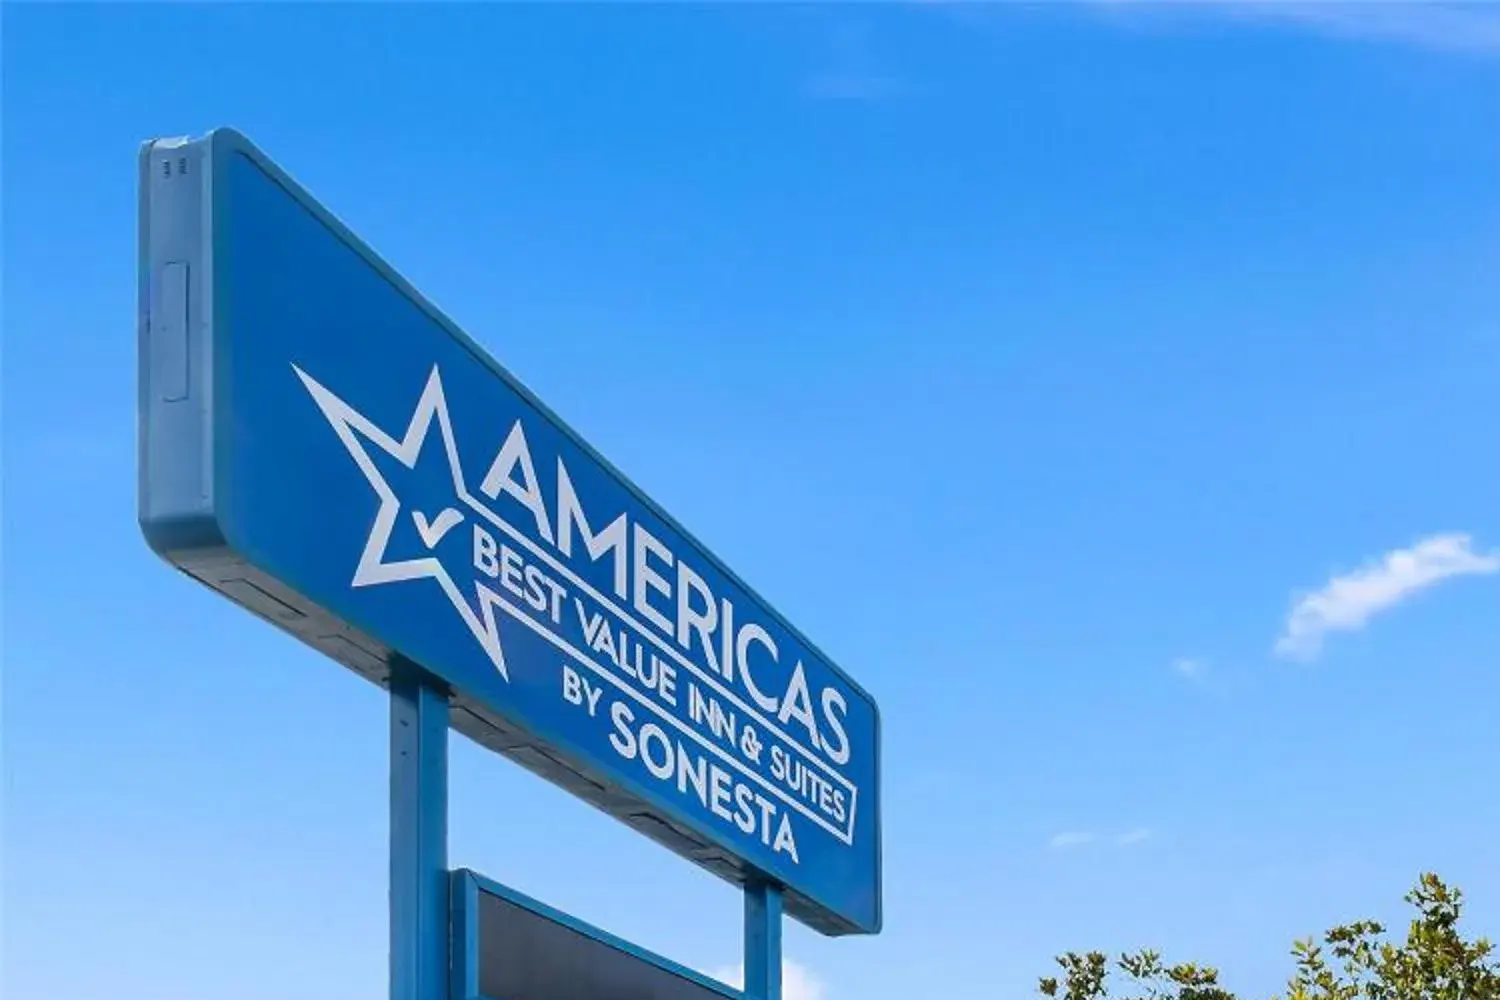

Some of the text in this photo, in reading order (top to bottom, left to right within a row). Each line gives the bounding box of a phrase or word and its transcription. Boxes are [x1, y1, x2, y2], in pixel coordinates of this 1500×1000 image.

[474, 525, 846, 822] BEST VALUE INN & SUITES
[480, 419, 850, 765] AMERICAS
[564, 666, 799, 864] BY SONESTA
